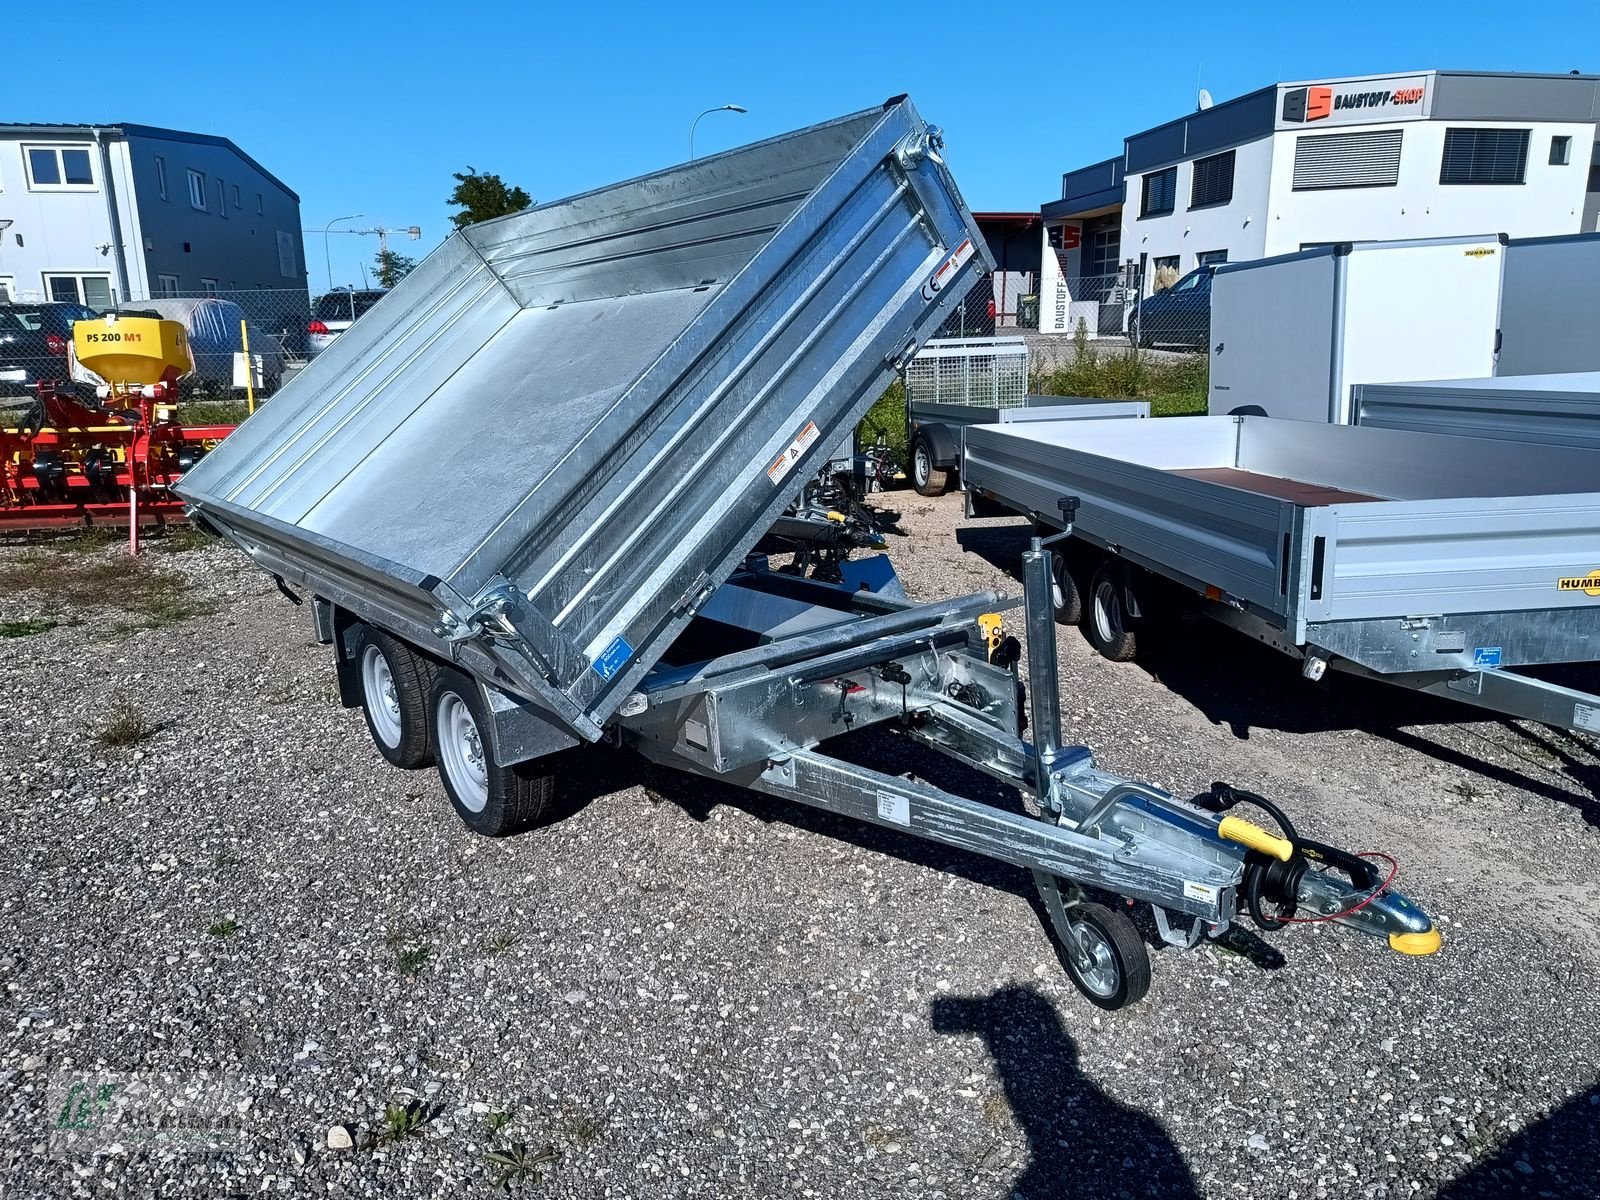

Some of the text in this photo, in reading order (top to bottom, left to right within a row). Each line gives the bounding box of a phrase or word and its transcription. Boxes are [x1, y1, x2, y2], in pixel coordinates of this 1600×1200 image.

[1333, 88, 1424, 110] BAUSTOFF-SHOP
[87, 333, 141, 342] PS 200 M1
[1561, 579, 1600, 589] HUMB
